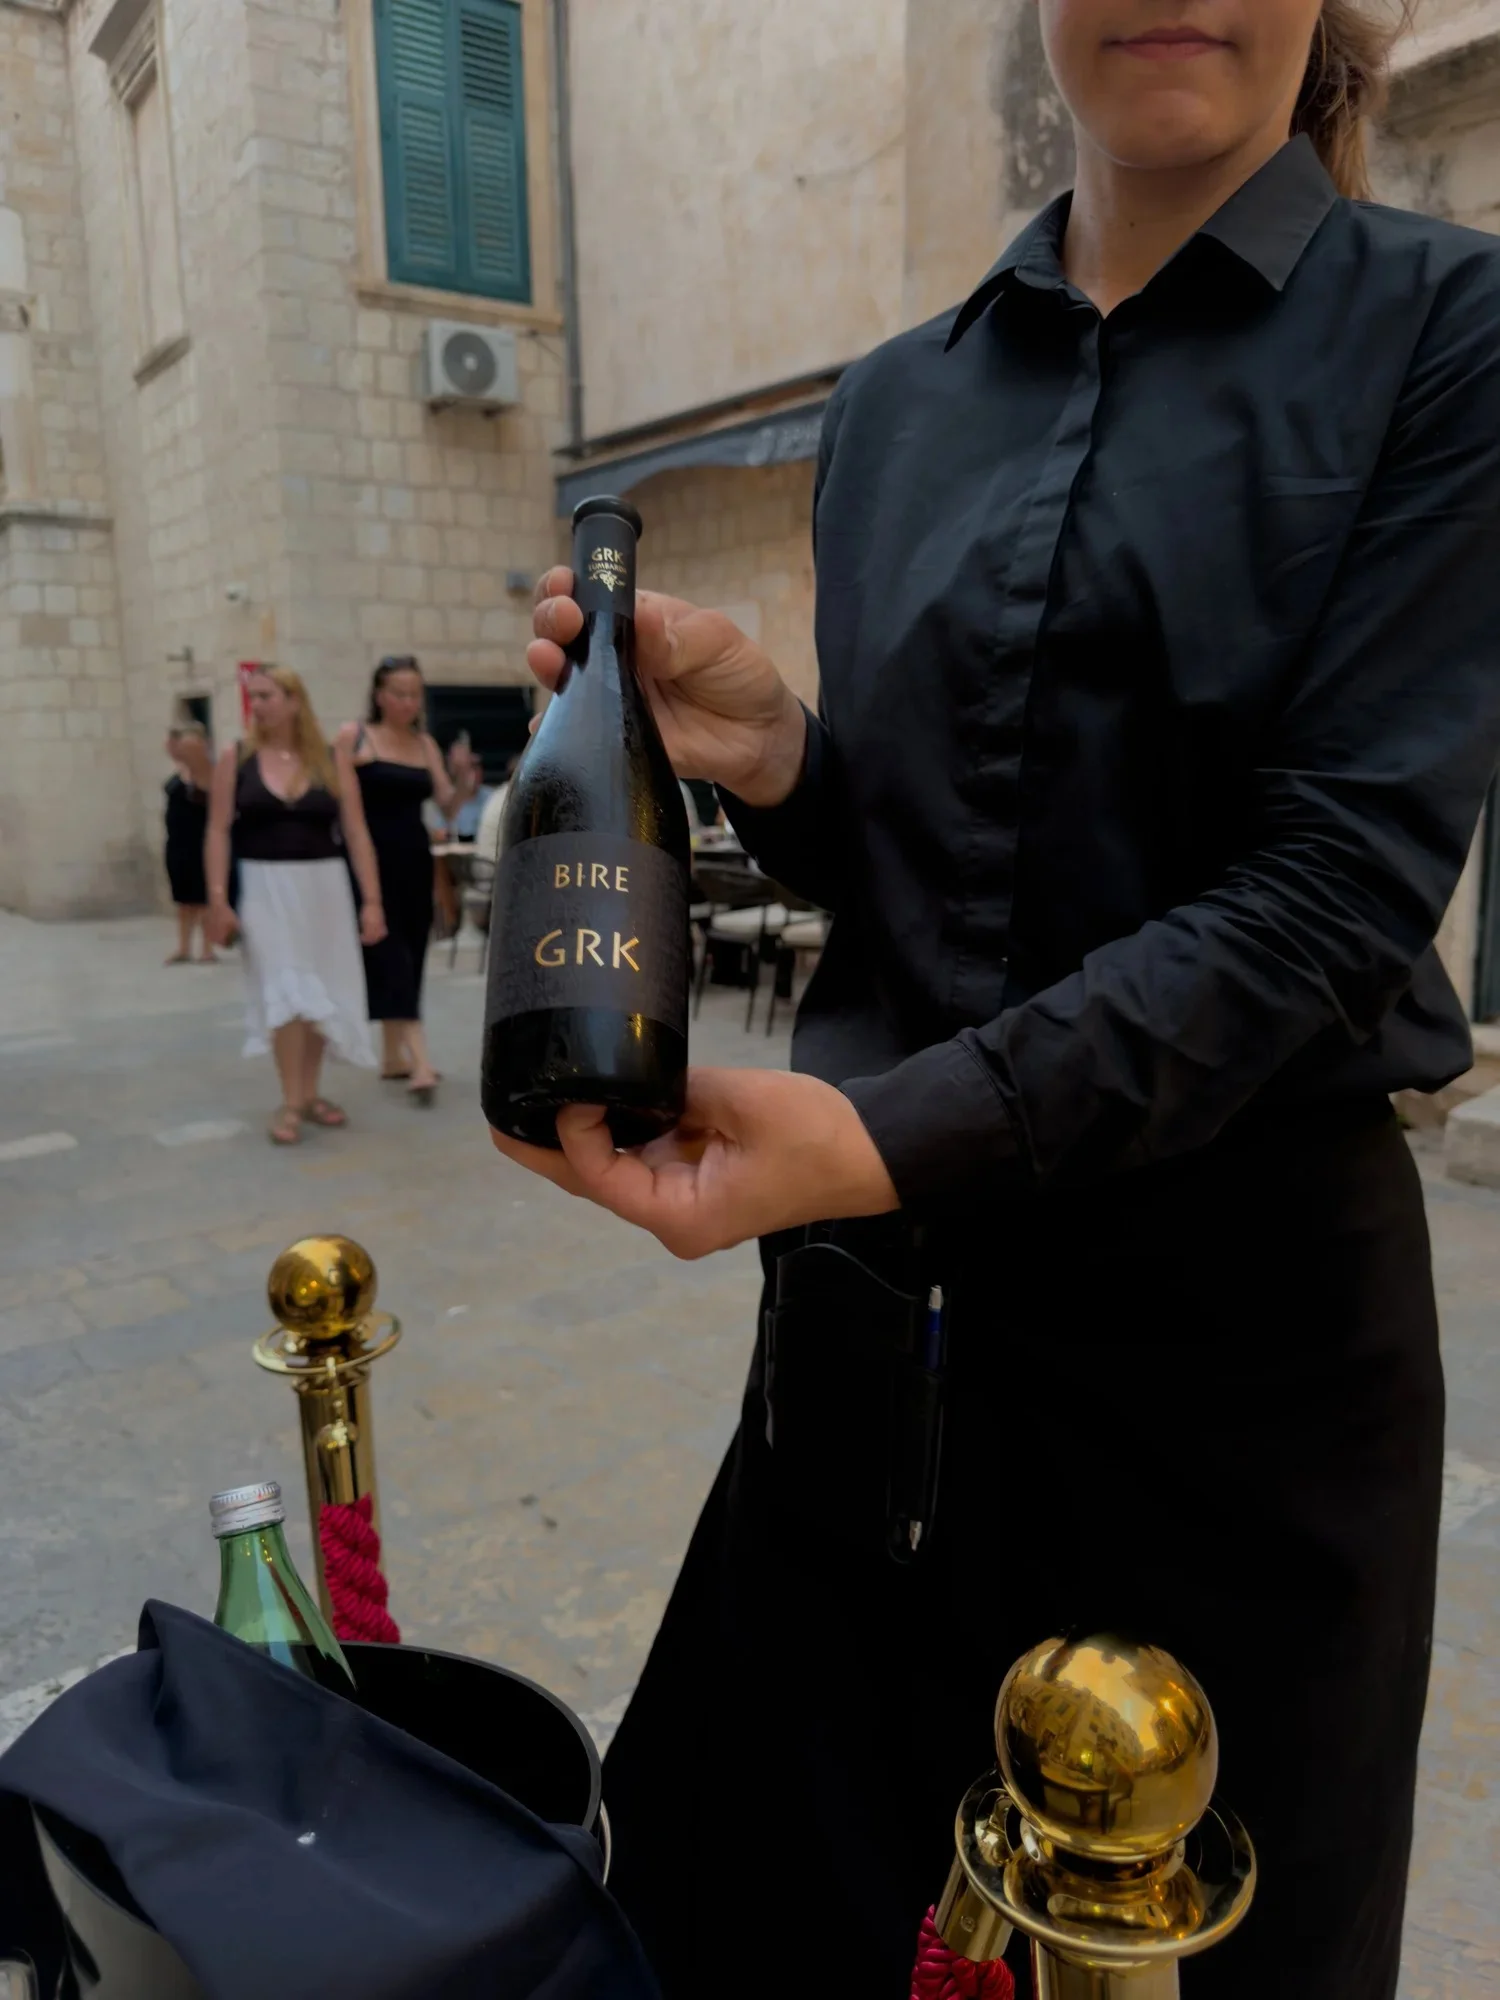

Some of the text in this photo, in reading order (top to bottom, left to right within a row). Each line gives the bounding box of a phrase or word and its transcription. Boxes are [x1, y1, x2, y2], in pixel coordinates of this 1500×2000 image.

[592, 547, 624, 563] GRK
[555, 862, 630, 893] BIRE
[535, 928, 640, 972] GRK
